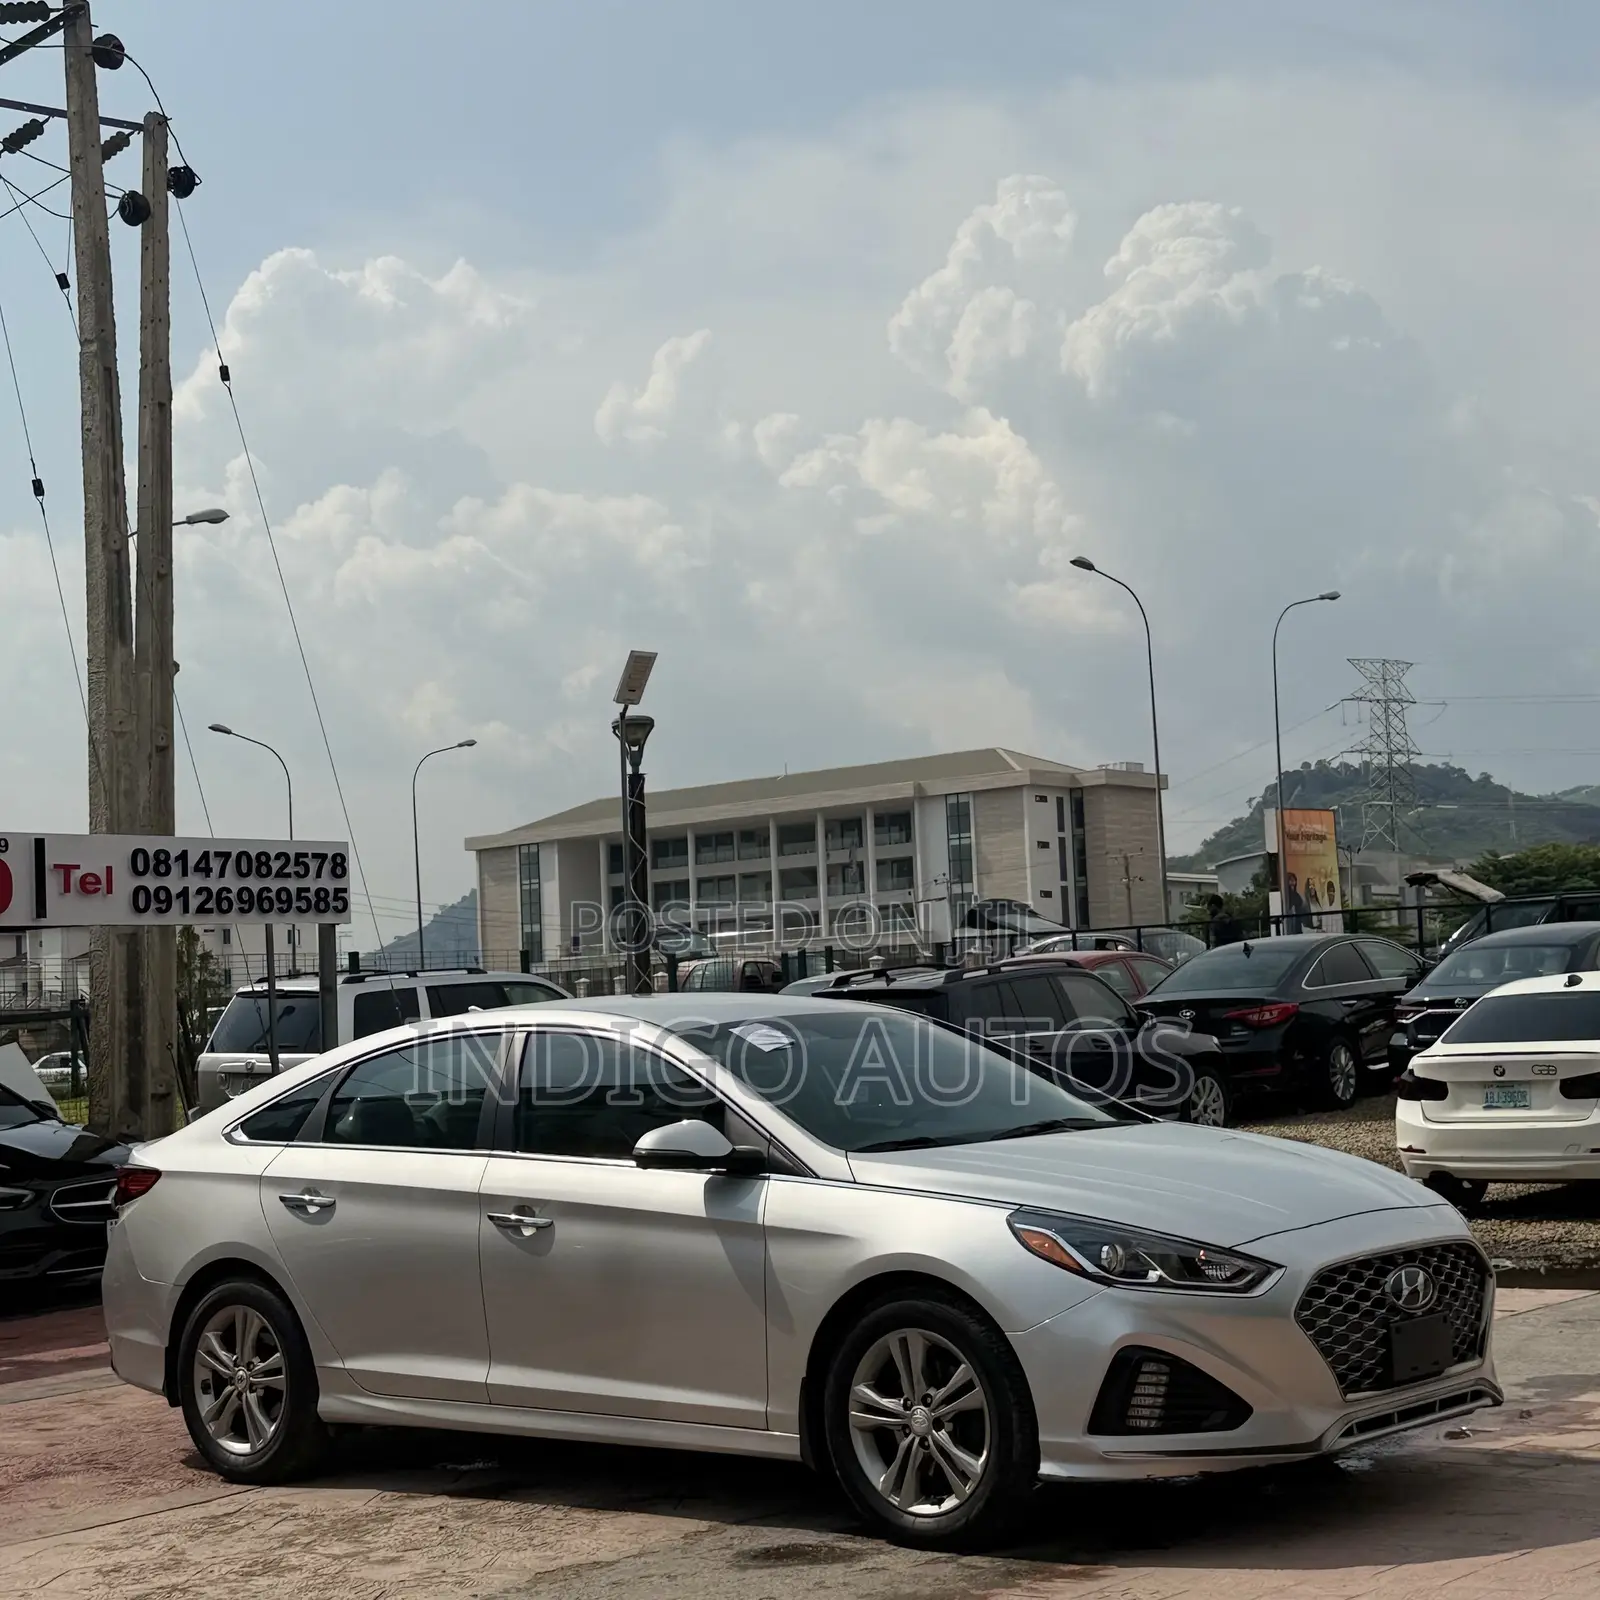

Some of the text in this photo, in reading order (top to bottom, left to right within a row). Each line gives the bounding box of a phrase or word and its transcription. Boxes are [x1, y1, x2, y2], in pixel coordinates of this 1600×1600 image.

[53, 863, 113, 895] Tel
[130, 848, 347, 879] 08147082578
[131, 885, 348, 914] 09126969585
